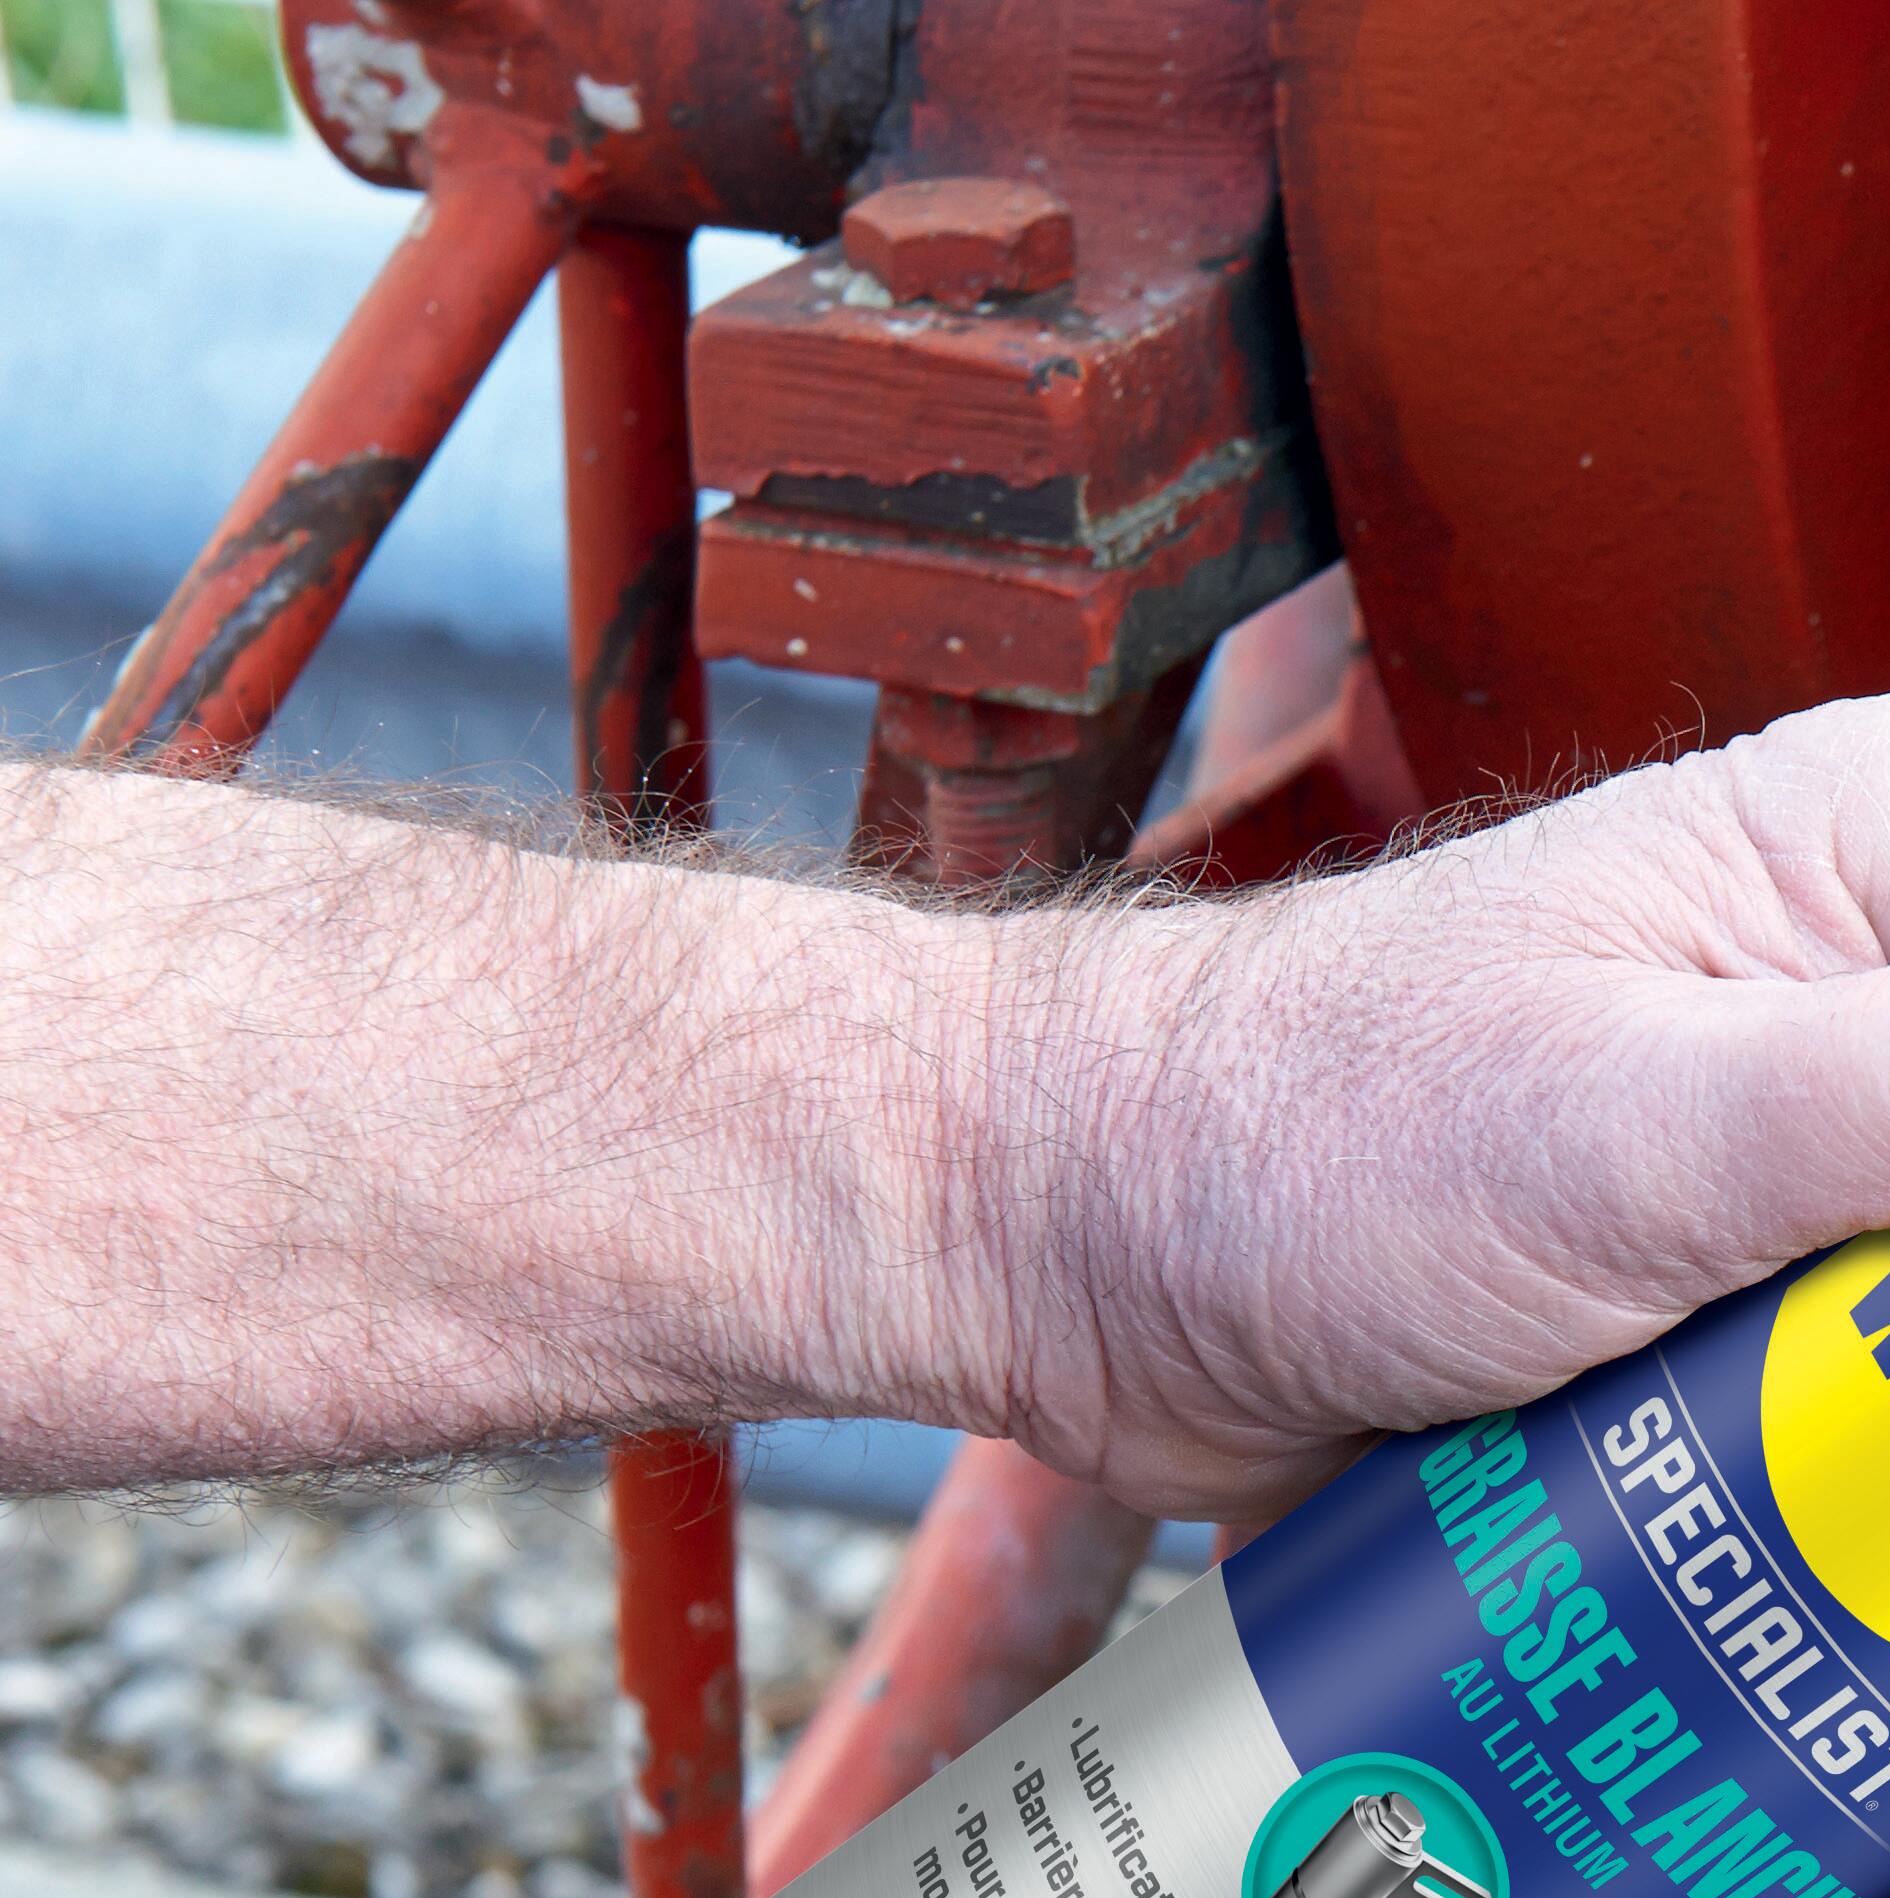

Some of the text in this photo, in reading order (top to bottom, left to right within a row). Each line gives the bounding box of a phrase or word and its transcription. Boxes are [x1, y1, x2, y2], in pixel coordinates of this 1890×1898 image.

[1419, 1407, 1636, 1724] GRAISSE
[1441, 1658, 1628, 1888] AU LITHIUM
